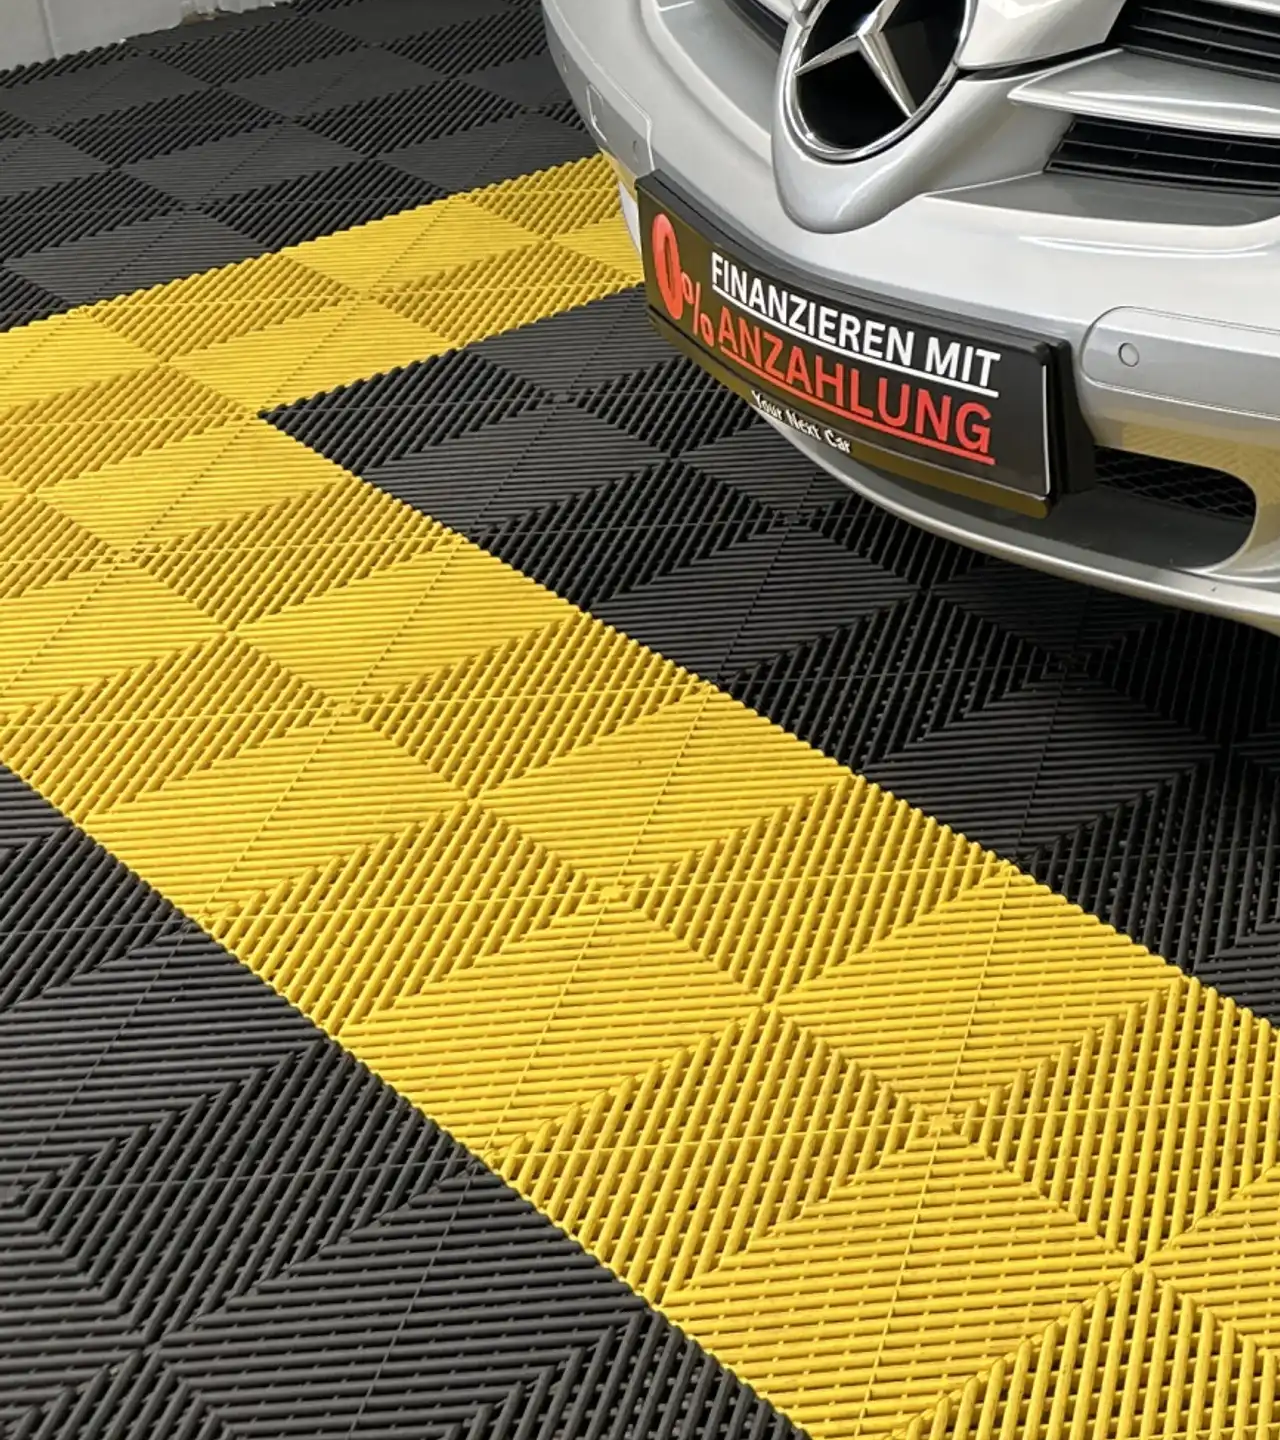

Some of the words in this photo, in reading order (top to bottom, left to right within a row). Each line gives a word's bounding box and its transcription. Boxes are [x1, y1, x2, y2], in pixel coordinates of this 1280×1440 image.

[652, 213, 714, 347] 0%
[712, 251, 915, 367] FINANZIEREN
[925, 336, 1001, 387] MIT
[718, 306, 992, 454] ANZAHLUNG
[752, 390, 782, 420] Your
[786, 409, 822, 440] Next
[824, 429, 851, 453] Car
